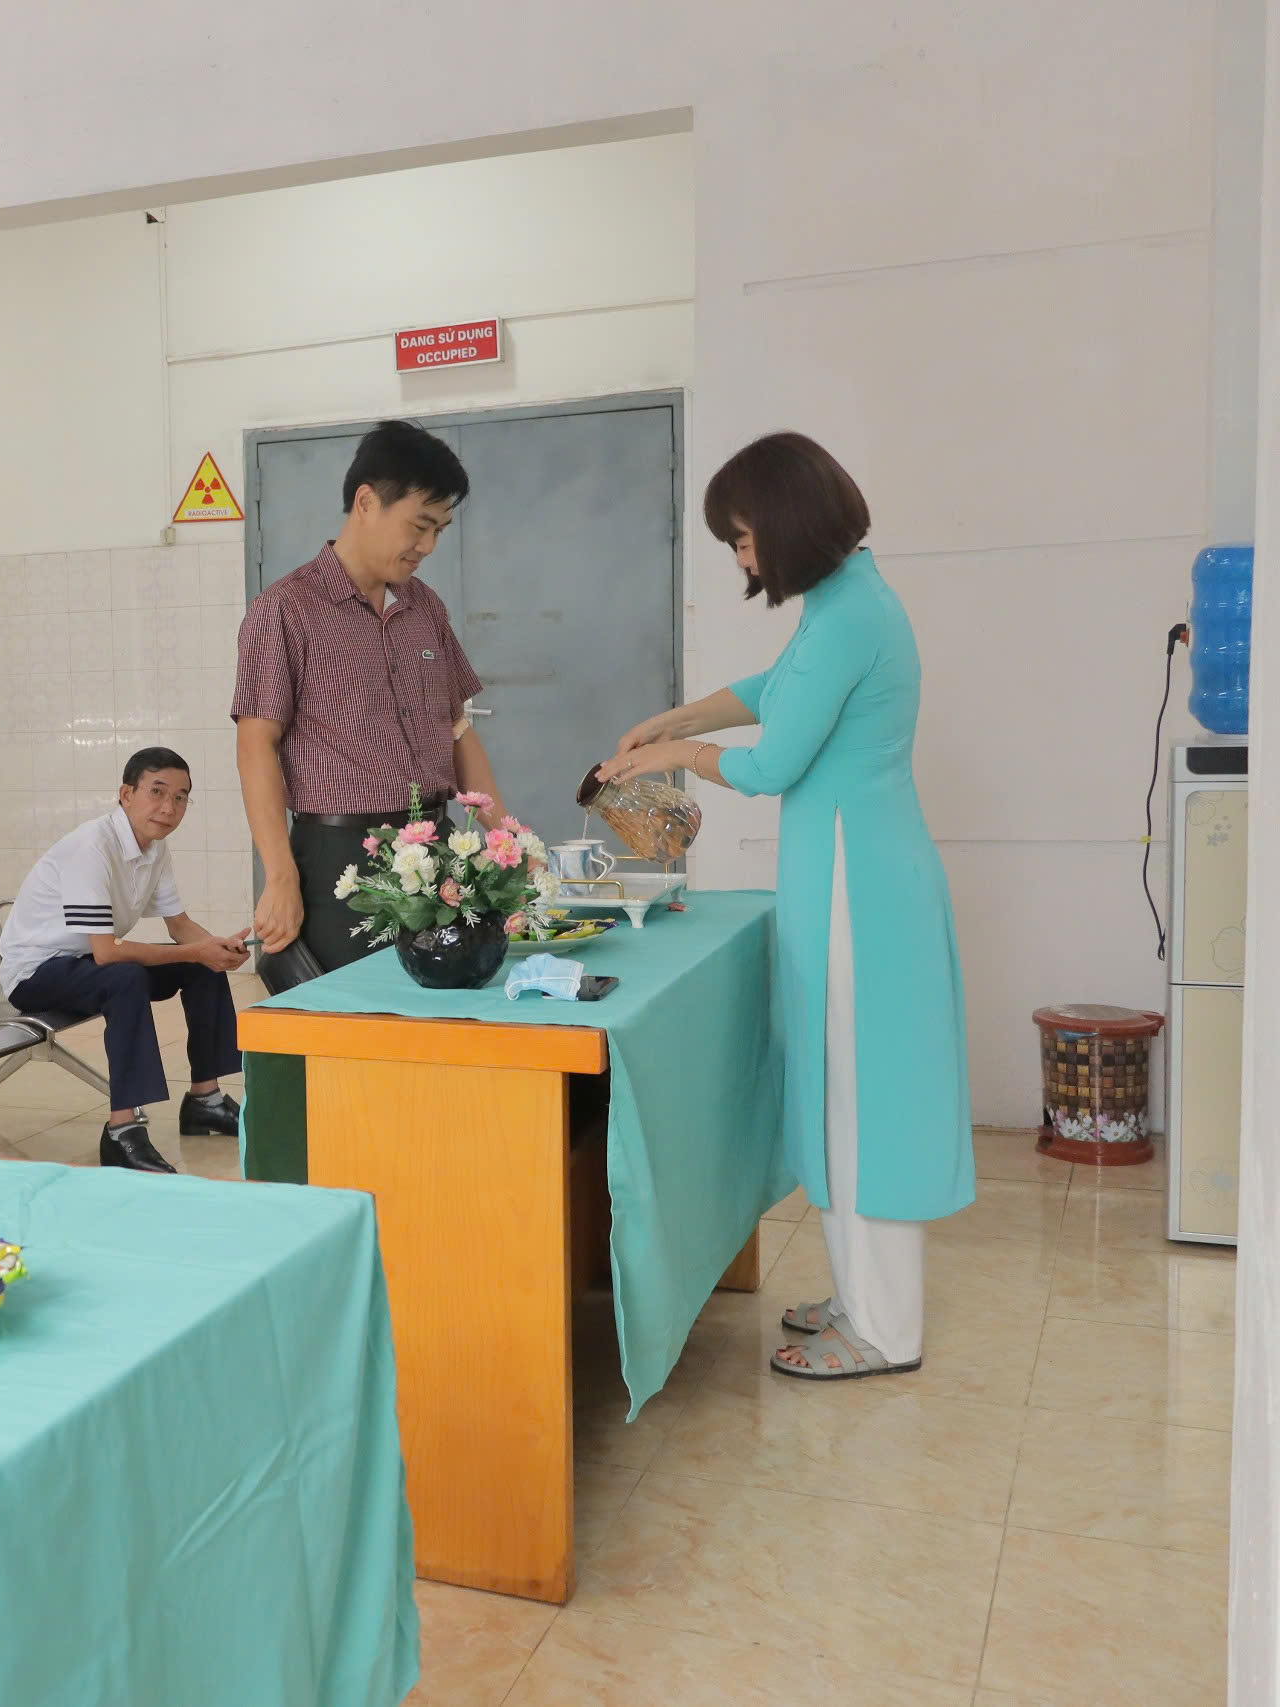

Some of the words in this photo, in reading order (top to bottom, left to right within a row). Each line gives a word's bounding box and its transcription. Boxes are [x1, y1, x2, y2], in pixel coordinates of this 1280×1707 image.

[400, 334, 435, 349] ĐANG
[458, 326, 493, 344] DỤNG
[417, 346, 478, 364] OCCUPIED
[188, 509, 228, 517] RADIOACTIVE
